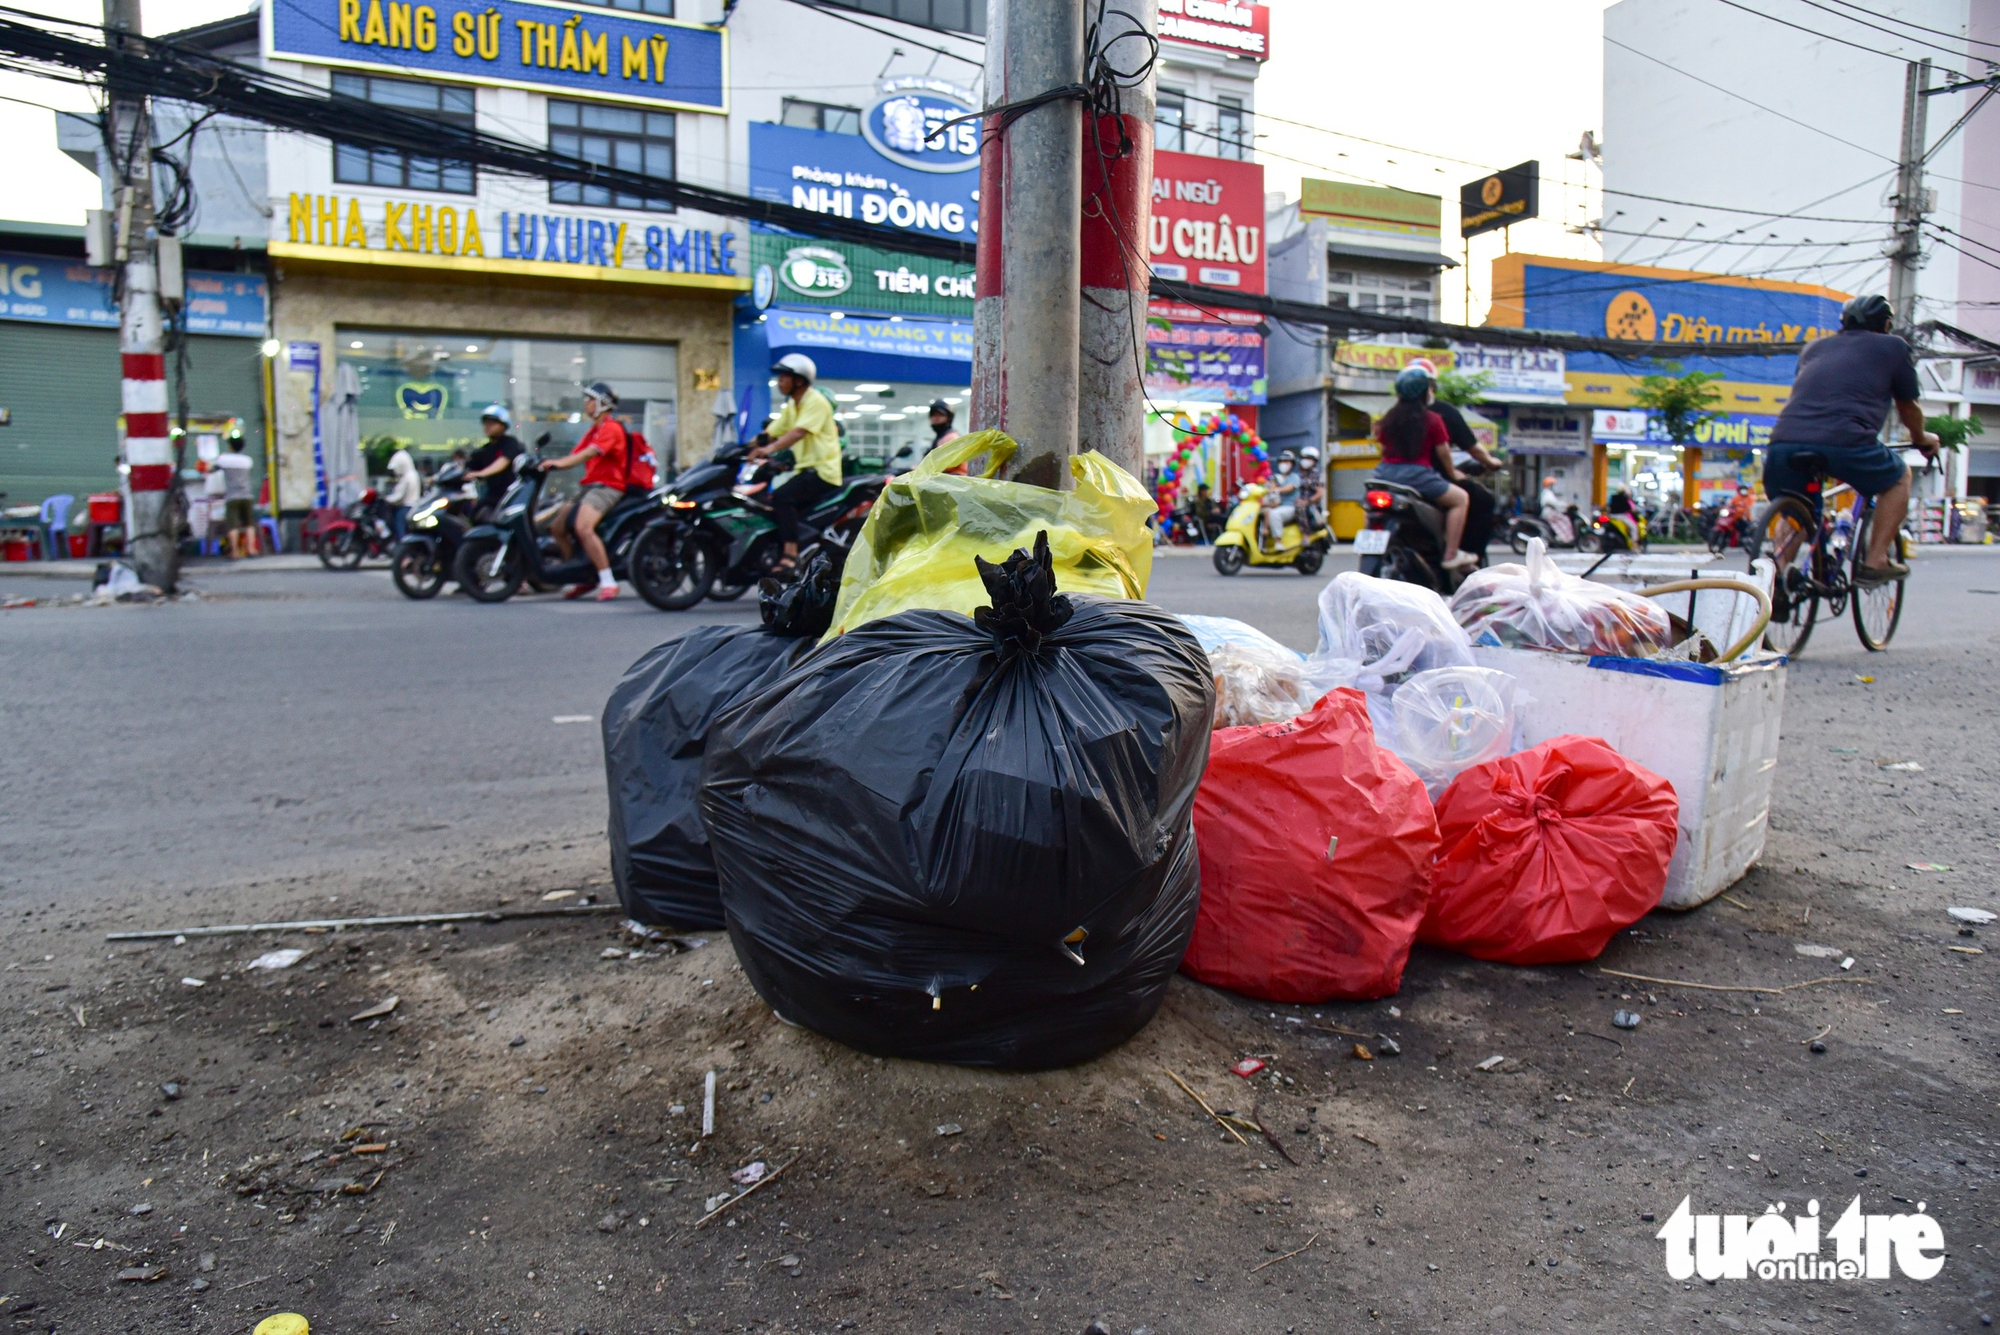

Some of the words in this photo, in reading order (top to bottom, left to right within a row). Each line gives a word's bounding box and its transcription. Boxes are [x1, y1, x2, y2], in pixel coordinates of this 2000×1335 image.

[453, 7, 501, 60] SỨ
[516, 13, 608, 76] THẨM
[622, 33, 668, 83] MỸ
[924, 120, 978, 155] 315
[792, 165, 842, 187] Phòng
[1175, 179, 1223, 205] NGỮ
[792, 185, 852, 218] NHI
[861, 182, 965, 233] ĐỒNG
[288, 192, 366, 248] NHA
[385, 202, 484, 257] KHOA
[501, 211, 627, 268] LUXURY
[645, 225, 736, 276] SMILE
[1172, 213, 1260, 264] CHÂU
[874, 266, 929, 295] TIÊM
